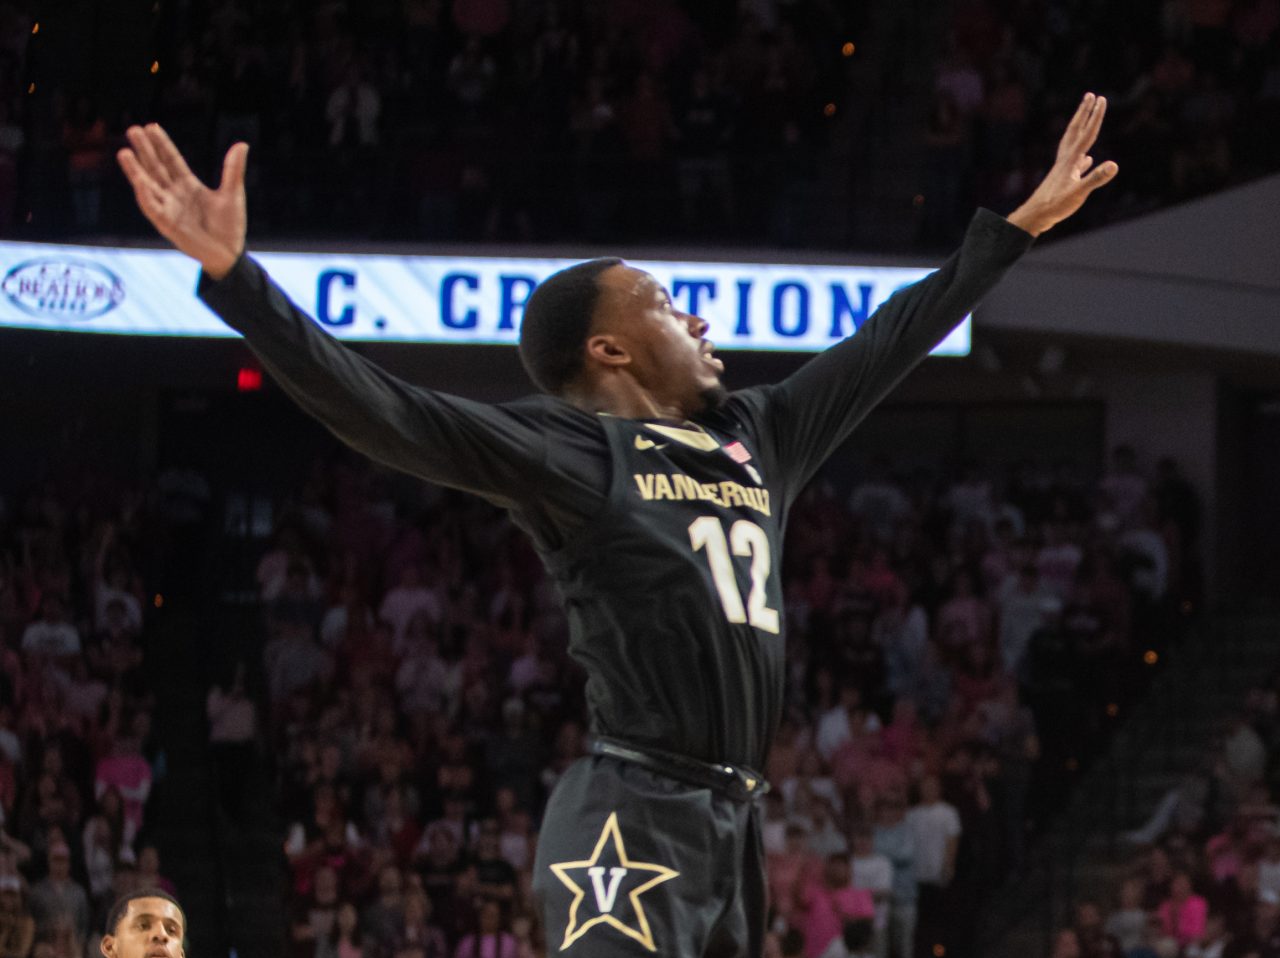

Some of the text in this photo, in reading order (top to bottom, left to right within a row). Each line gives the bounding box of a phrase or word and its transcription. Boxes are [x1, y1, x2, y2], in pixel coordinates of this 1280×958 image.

[316, 268, 873, 338] C. CRTION
[688, 516, 780, 635] 12
[588, 866, 627, 913] V
